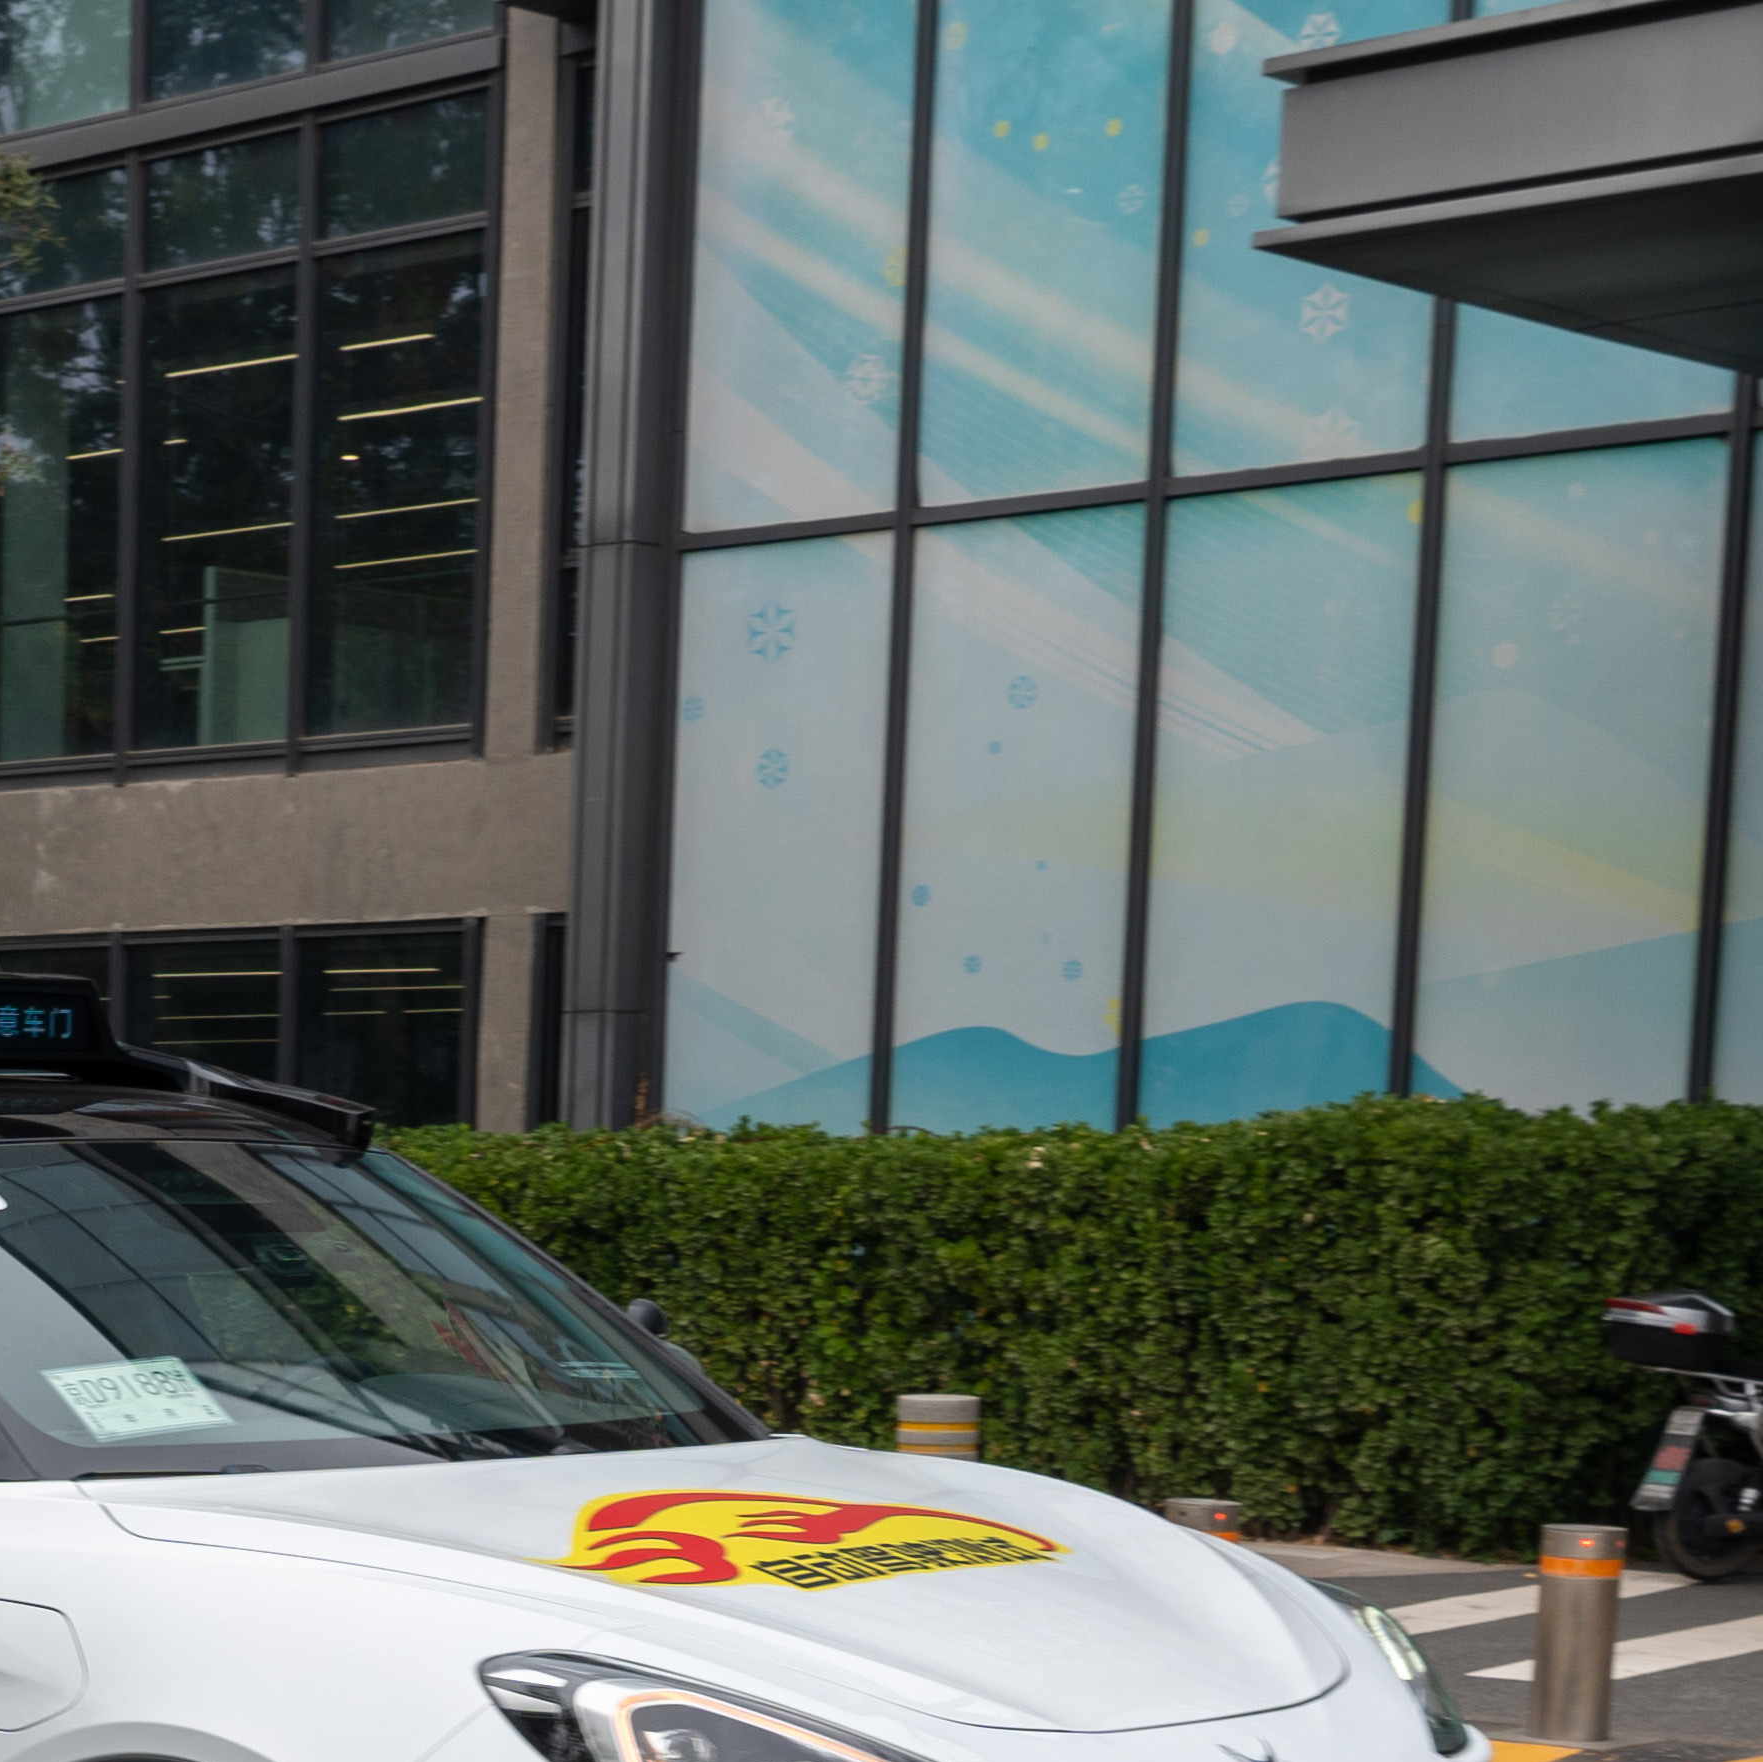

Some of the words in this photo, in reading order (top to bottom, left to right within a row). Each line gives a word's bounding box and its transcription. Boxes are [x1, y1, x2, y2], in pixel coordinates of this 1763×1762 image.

[747, 1536, 1059, 1589] 自动驾驶测试
